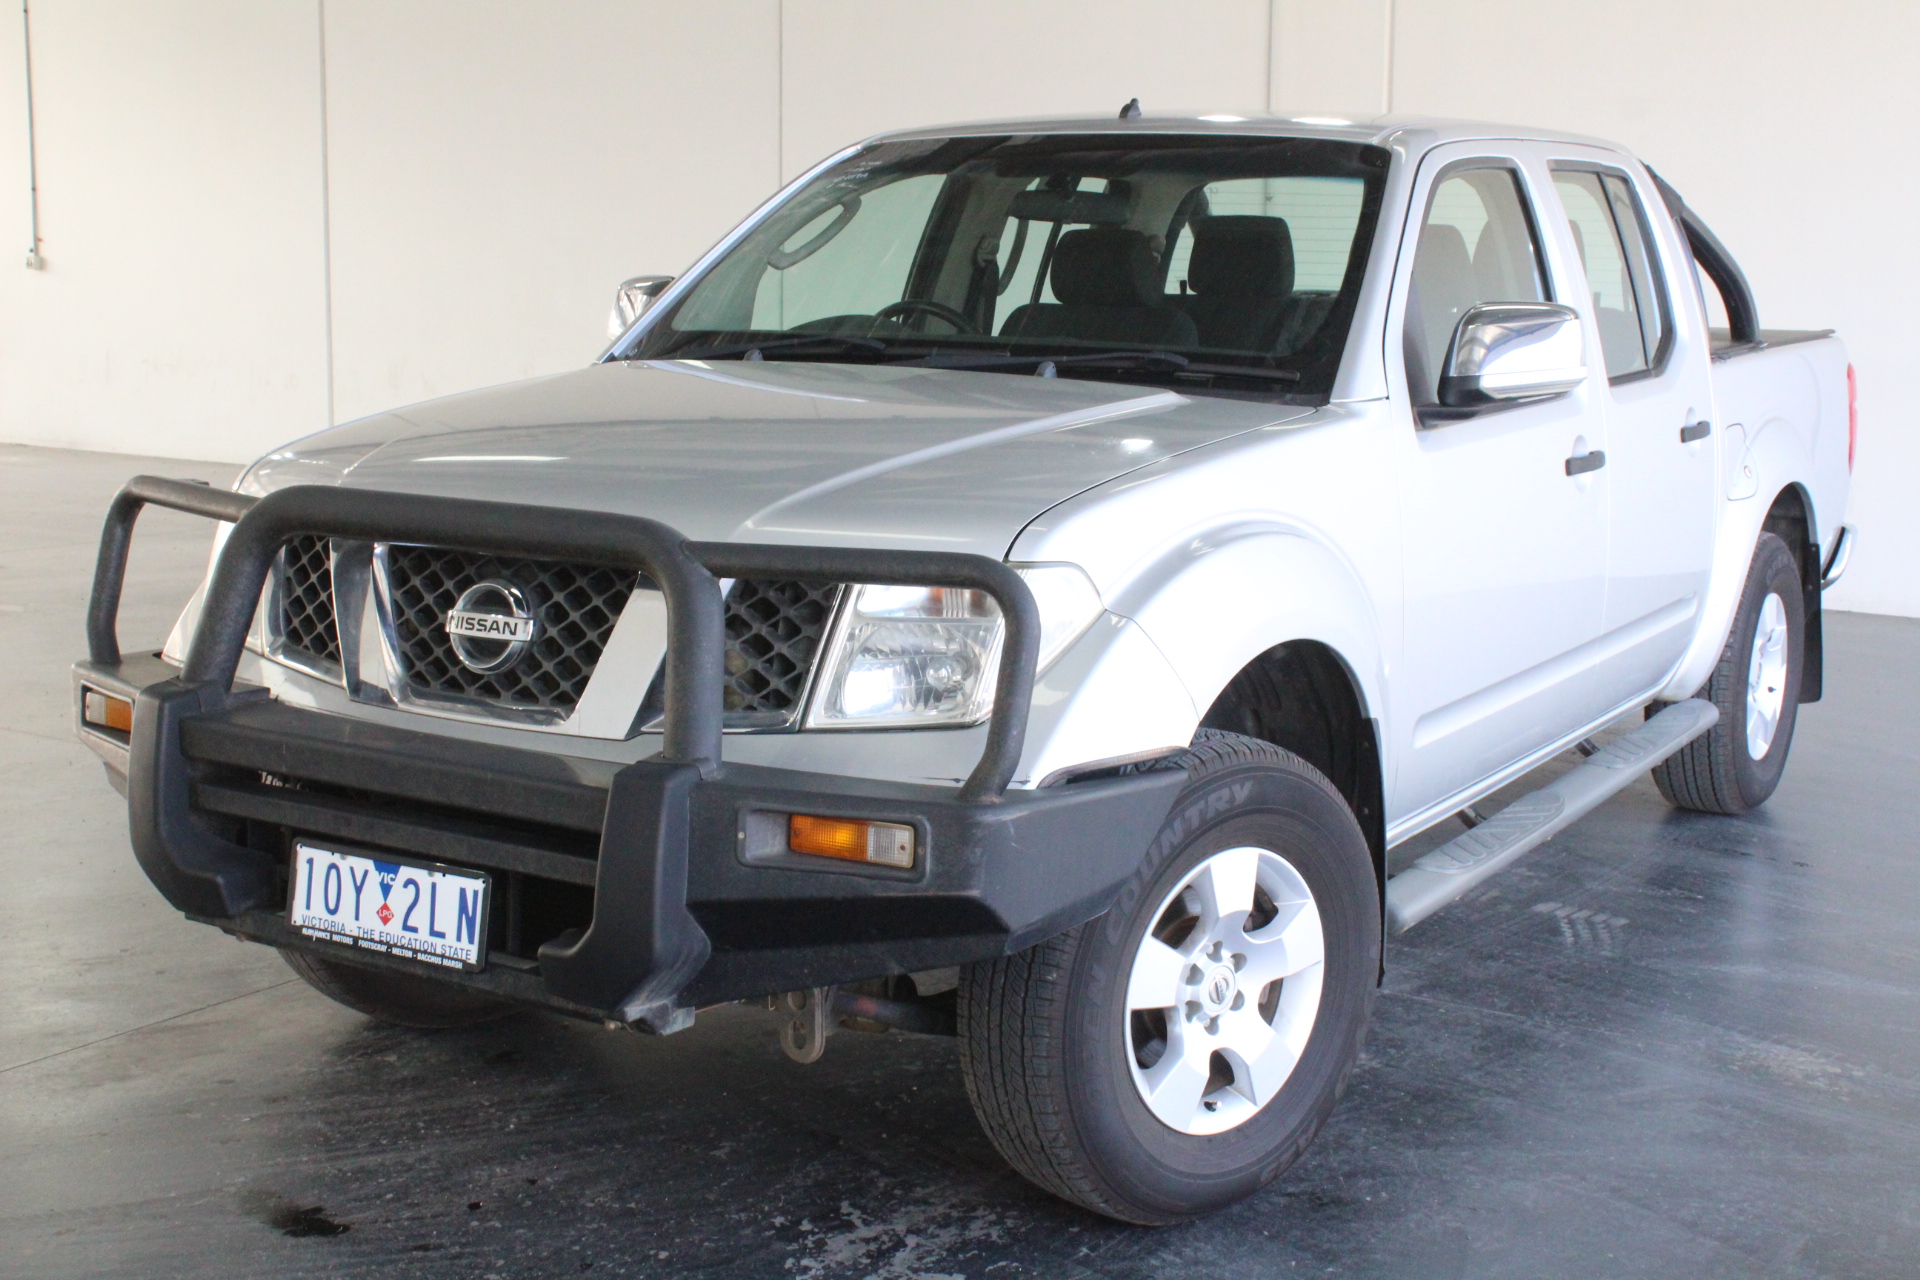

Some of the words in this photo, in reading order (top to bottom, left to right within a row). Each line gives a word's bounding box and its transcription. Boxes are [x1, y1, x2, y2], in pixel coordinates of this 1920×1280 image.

[450, 615, 518, 636] NISSAN
[375, 870, 396, 885] VIC
[378, 908, 393, 919] LPG
[401, 877, 479, 945] 2LN
[301, 914, 346, 933] VICTORIA
[356, 926, 376, 941] THE
[379, 931, 437, 953] EDUCATION
[441, 945, 472, 961] STATE
[332, 934, 353, 945] MOTORS
[391, 947, 413, 958] MELTON
[417, 952, 442, 965] BACCHUS
[442, 958, 463, 969] MARSH
